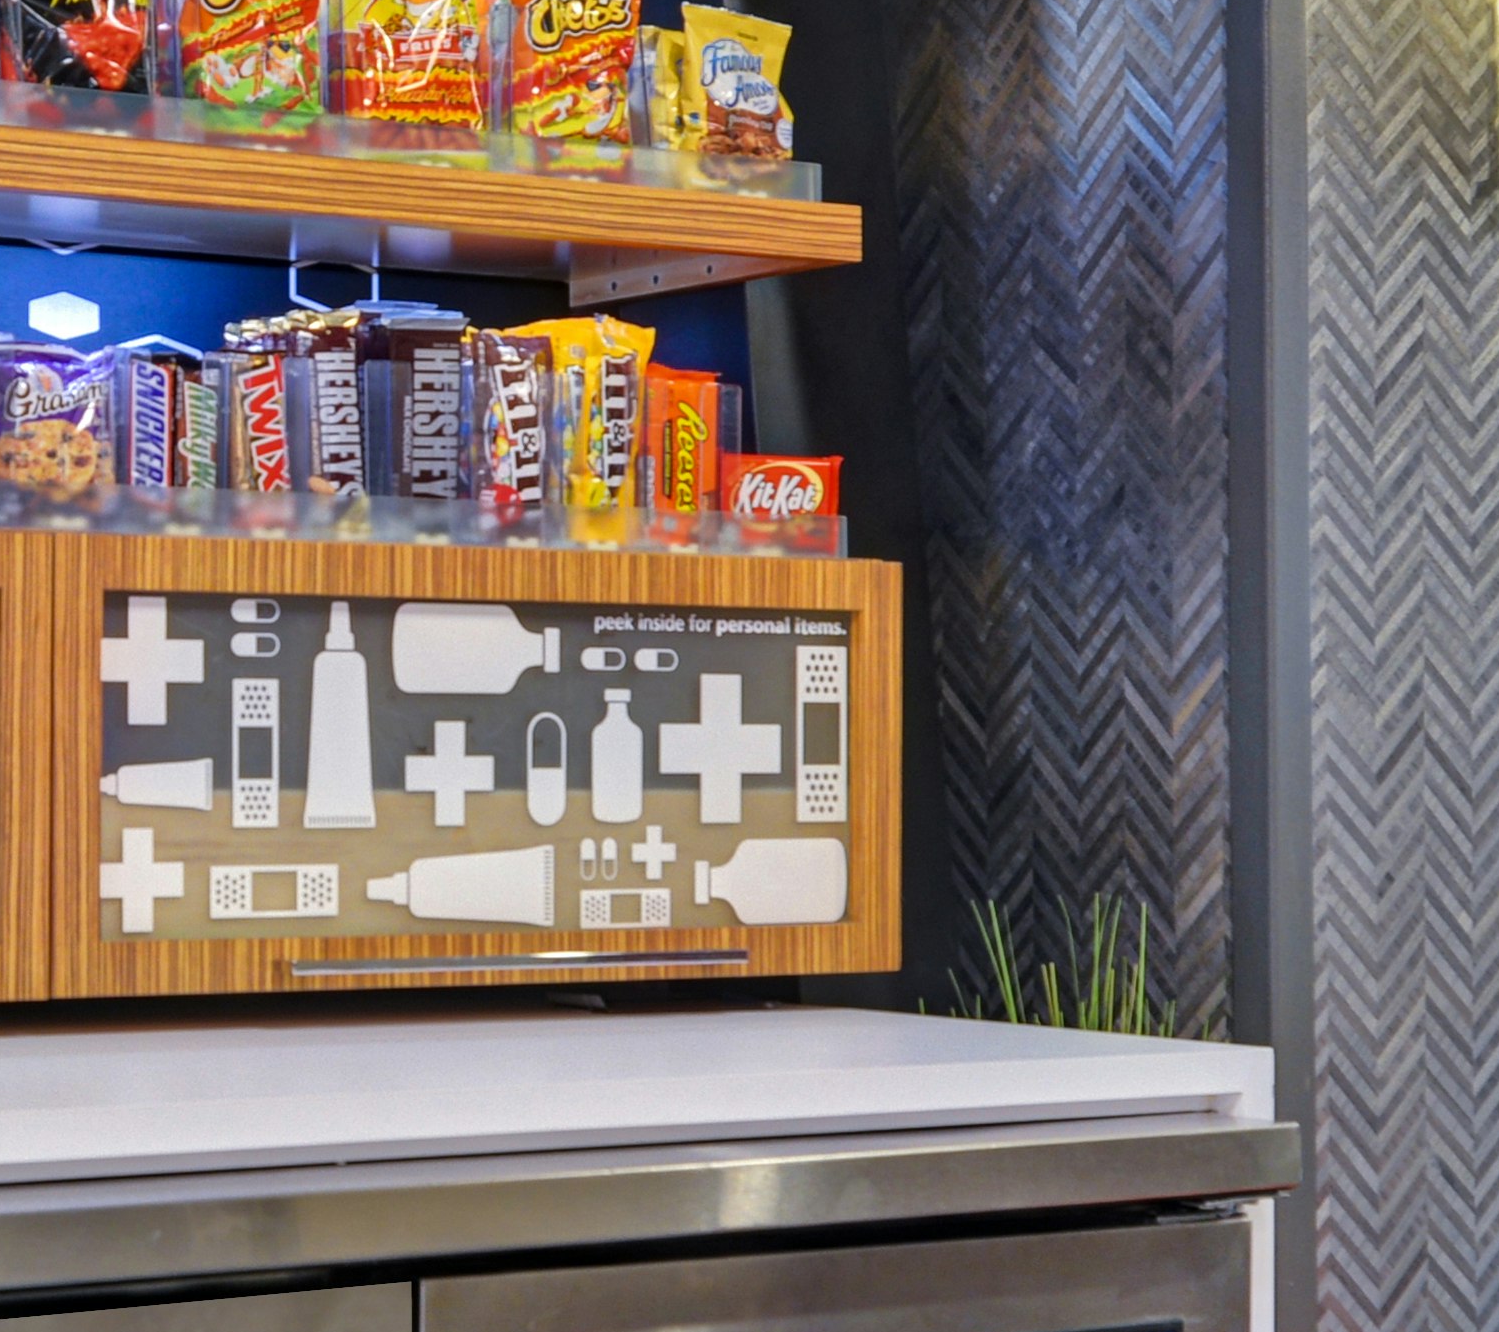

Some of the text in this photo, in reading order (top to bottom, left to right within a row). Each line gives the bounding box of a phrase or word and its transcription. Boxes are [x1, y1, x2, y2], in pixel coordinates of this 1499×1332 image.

[243, 354, 291, 493] TWIX
[594, 613, 848, 637] peek inside for personal items.
